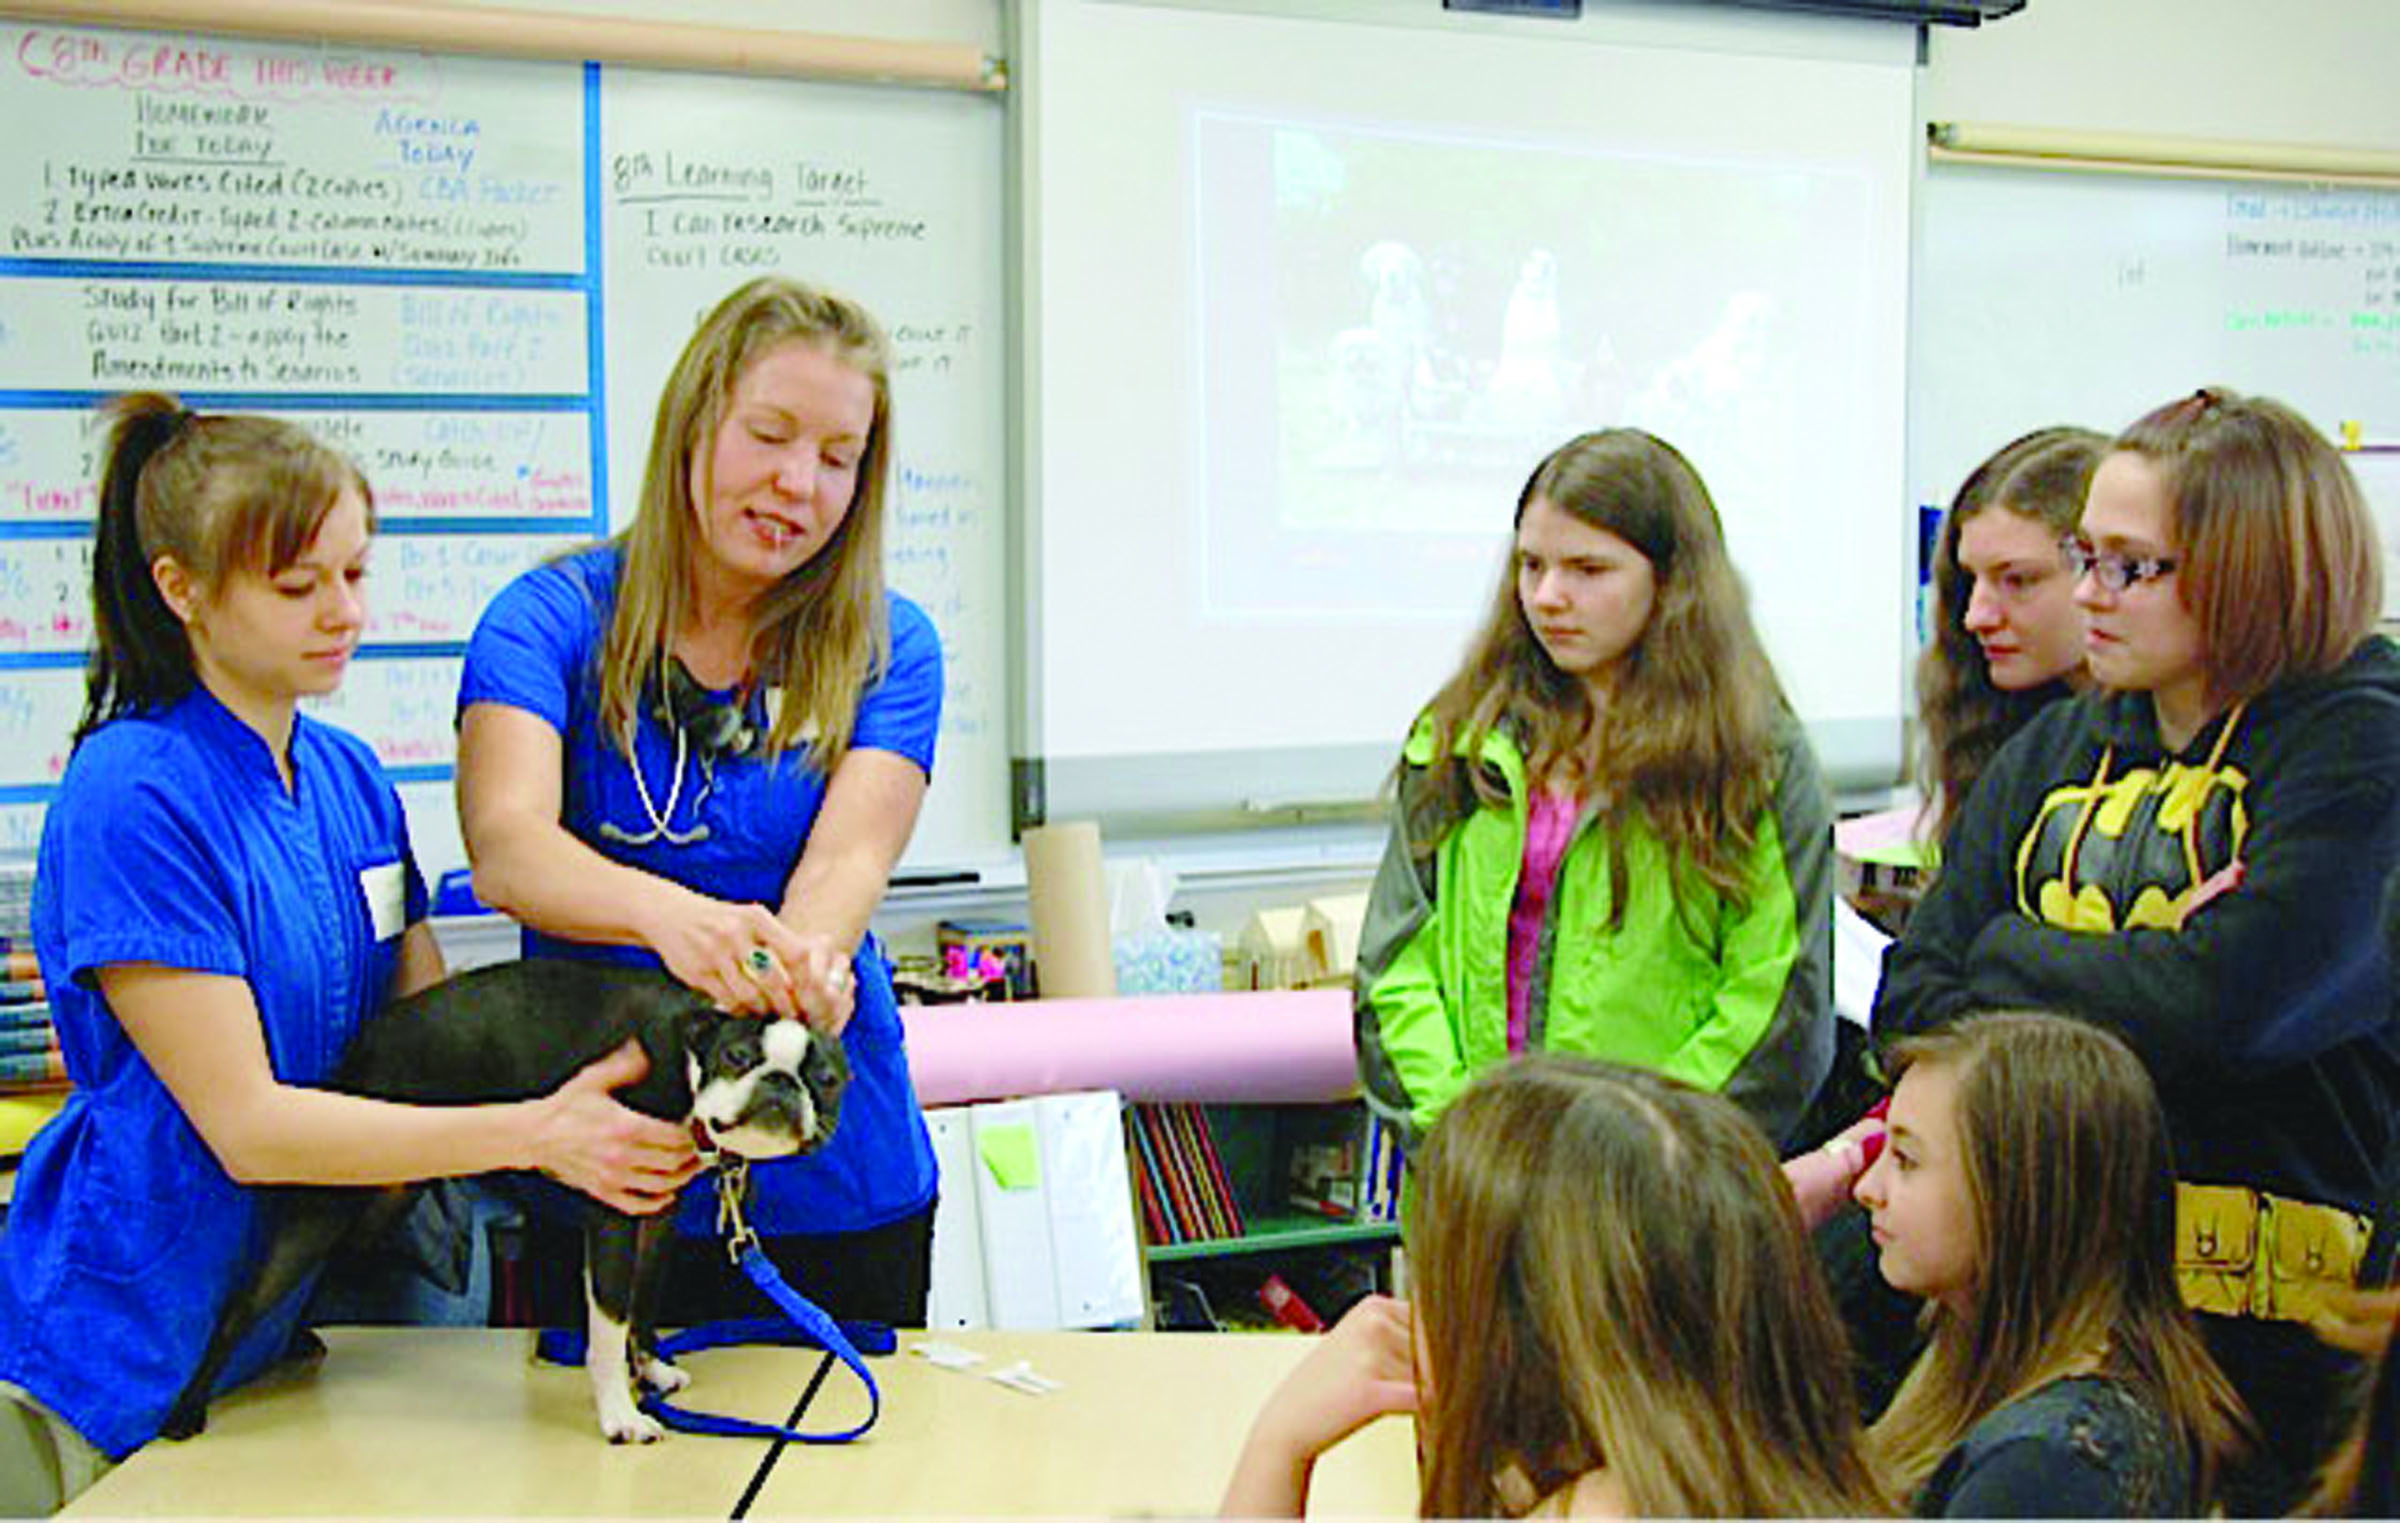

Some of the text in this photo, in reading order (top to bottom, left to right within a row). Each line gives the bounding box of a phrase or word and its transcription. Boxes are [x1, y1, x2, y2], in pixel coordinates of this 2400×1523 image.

[122, 40, 232, 82] GRADE
[666, 150, 774, 200] Learning
[796, 160, 869, 200] Target
[722, 214, 827, 238] research
[836, 214, 927, 241] Supreme
[84, 286, 156, 322] Study
[210, 287, 250, 314] Bill
[284, 289, 358, 322] Rights
